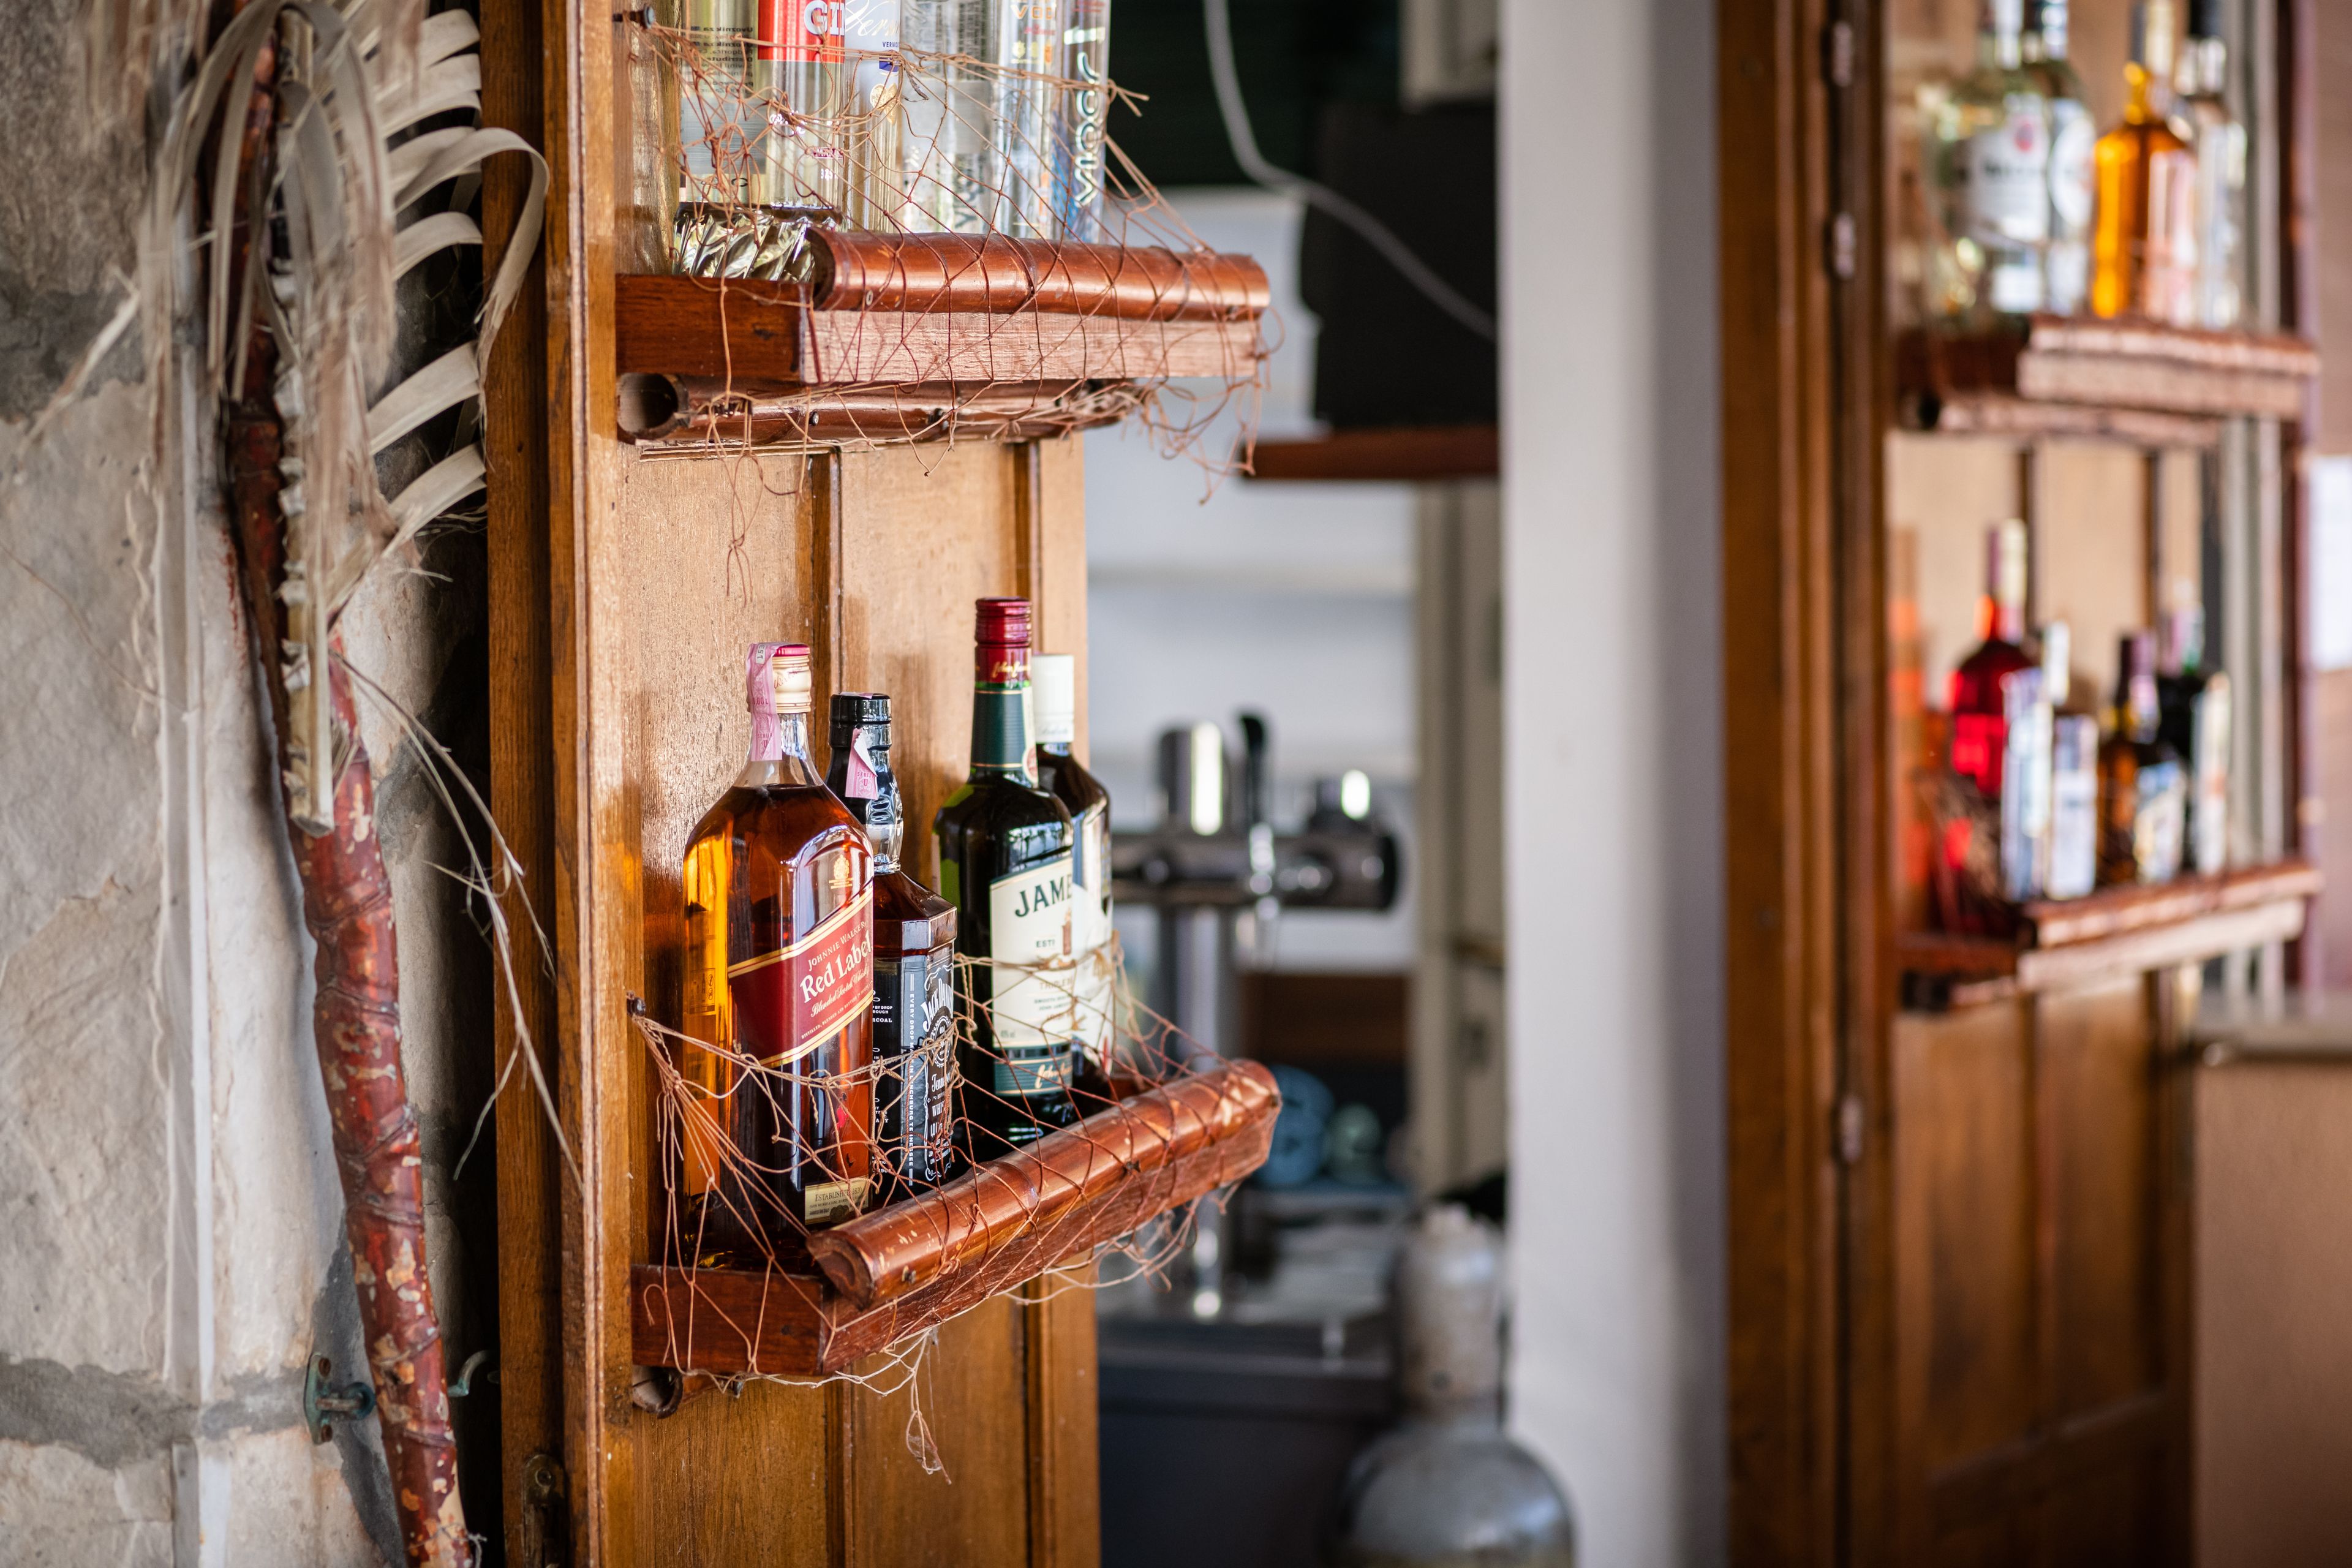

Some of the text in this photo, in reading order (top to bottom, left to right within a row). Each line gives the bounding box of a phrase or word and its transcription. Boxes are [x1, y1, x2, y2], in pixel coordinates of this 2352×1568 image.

[799, 930, 872, 1003] Red Label
[810, 989, 839, 1018] Blended
